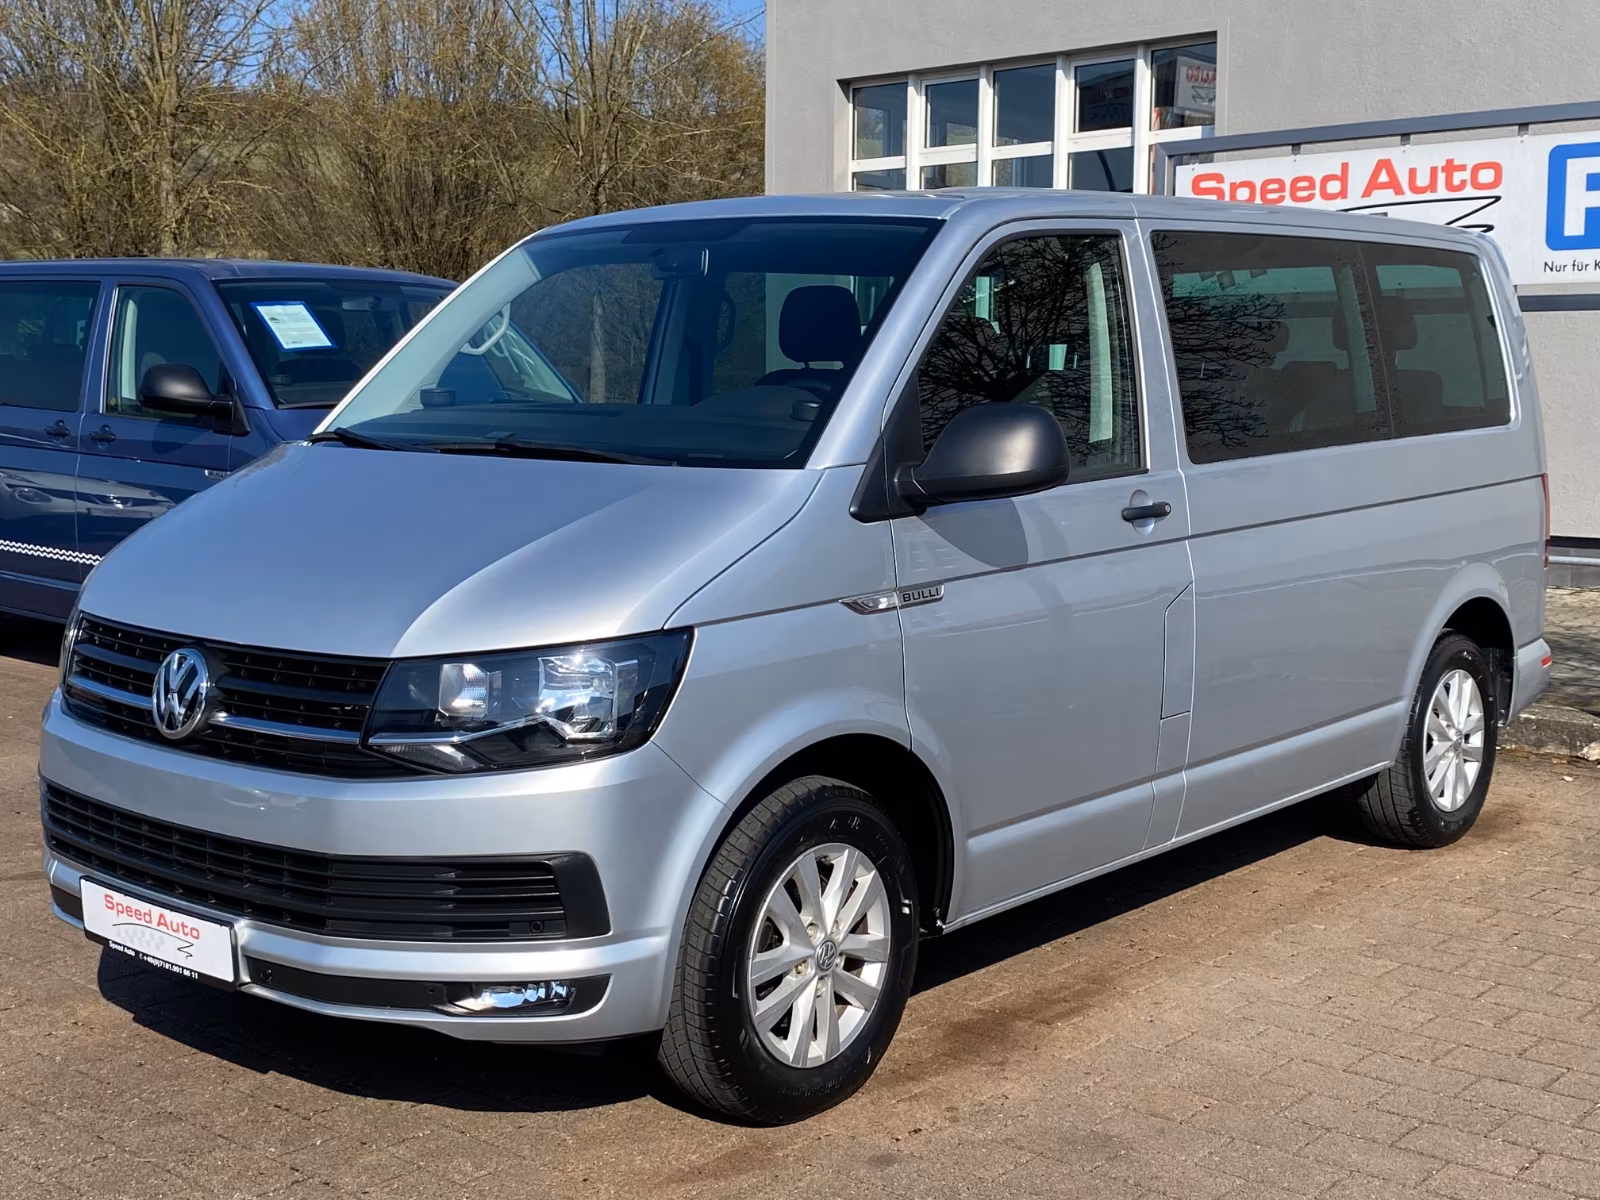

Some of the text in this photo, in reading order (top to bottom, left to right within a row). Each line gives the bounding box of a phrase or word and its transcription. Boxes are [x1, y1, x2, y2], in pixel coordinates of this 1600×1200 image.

[1191, 158, 1503, 206] Speed Auto
[1543, 261, 1568, 273] Nur
[1572, 259, 1590, 272] für
[902, 587, 939, 602] BULLI
[104, 894, 200, 940] Speed Auto
[108, 940, 124, 952] Speed
[124, 946, 136, 957] Auto
